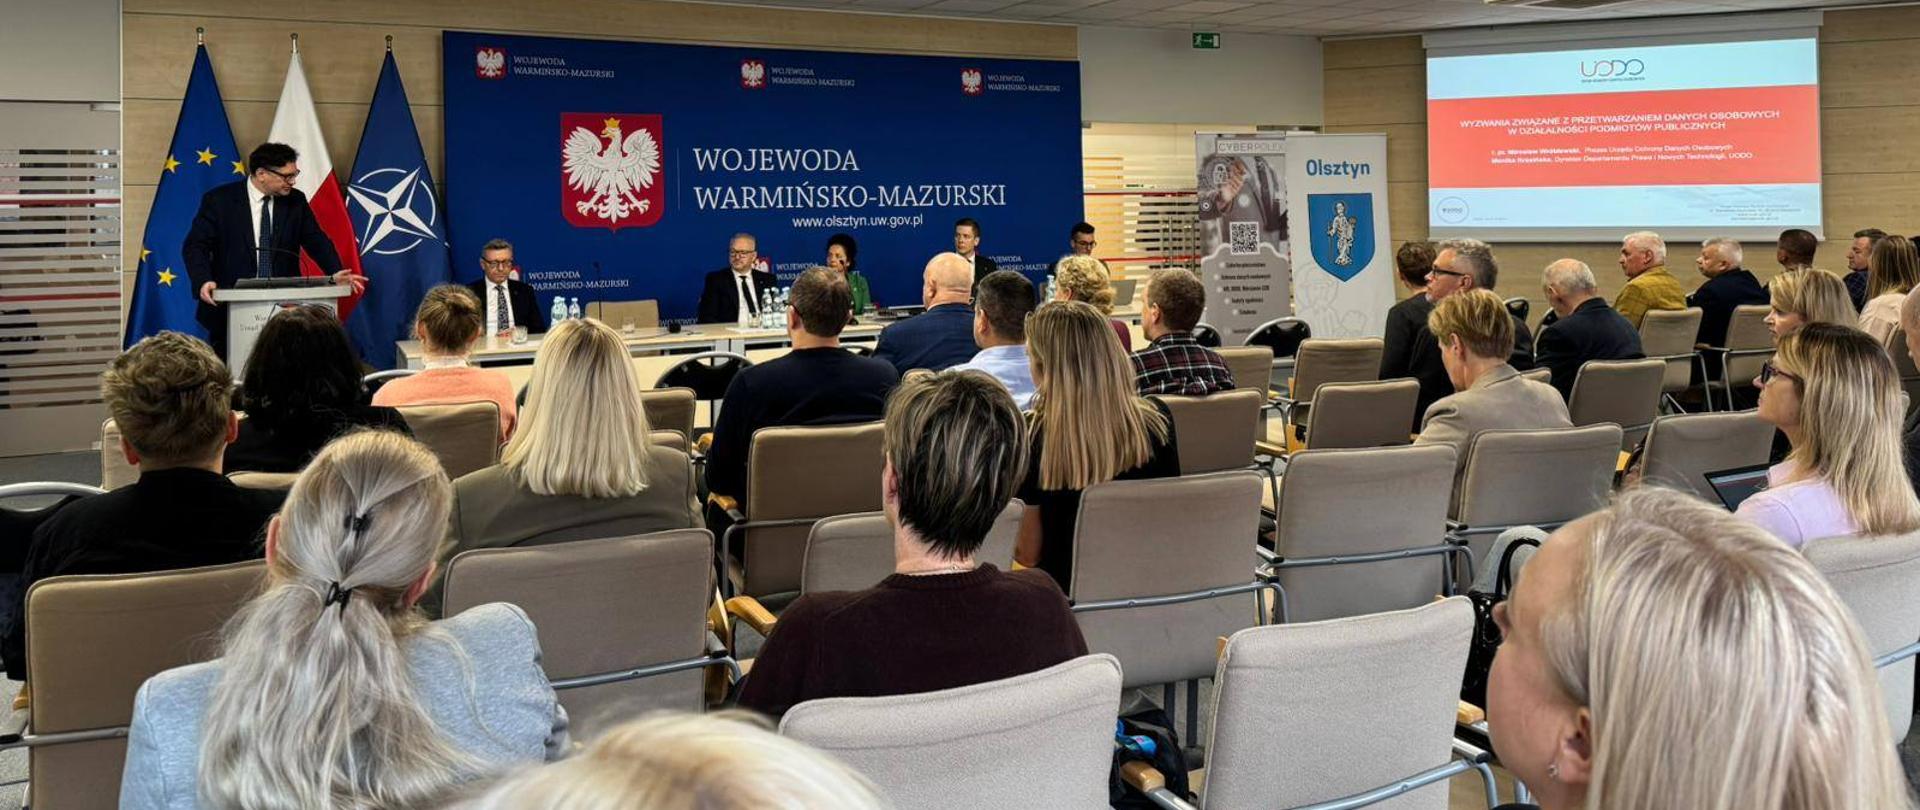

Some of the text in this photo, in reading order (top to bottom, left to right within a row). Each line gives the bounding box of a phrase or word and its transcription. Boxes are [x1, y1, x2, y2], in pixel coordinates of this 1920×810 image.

[513, 55, 566, 66] WOJEWODA
[513, 65, 615, 78] WARMIŃSKO-MAZURSKI
[1460, 119, 1511, 128] WYZWANIA
[1563, 117, 1570, 125] Z
[1571, 113, 1662, 125] PRZETWARZANIEM
[1664, 112, 1707, 122] DANYCH
[1709, 110, 1780, 121] OSOBOWYCH
[1508, 127, 1518, 136] W
[1654, 121, 1727, 132] PUBLICZNYCH
[692, 148, 860, 172] WOJEWODA
[1306, 159, 1371, 179] Olsztyn
[693, 180, 1007, 210] WARMIŃSKO-MAZURSKI
[792, 213, 923, 231] www.olsztyn.uw.gov.pl
[528, 270, 581, 281] WOJEWODA
